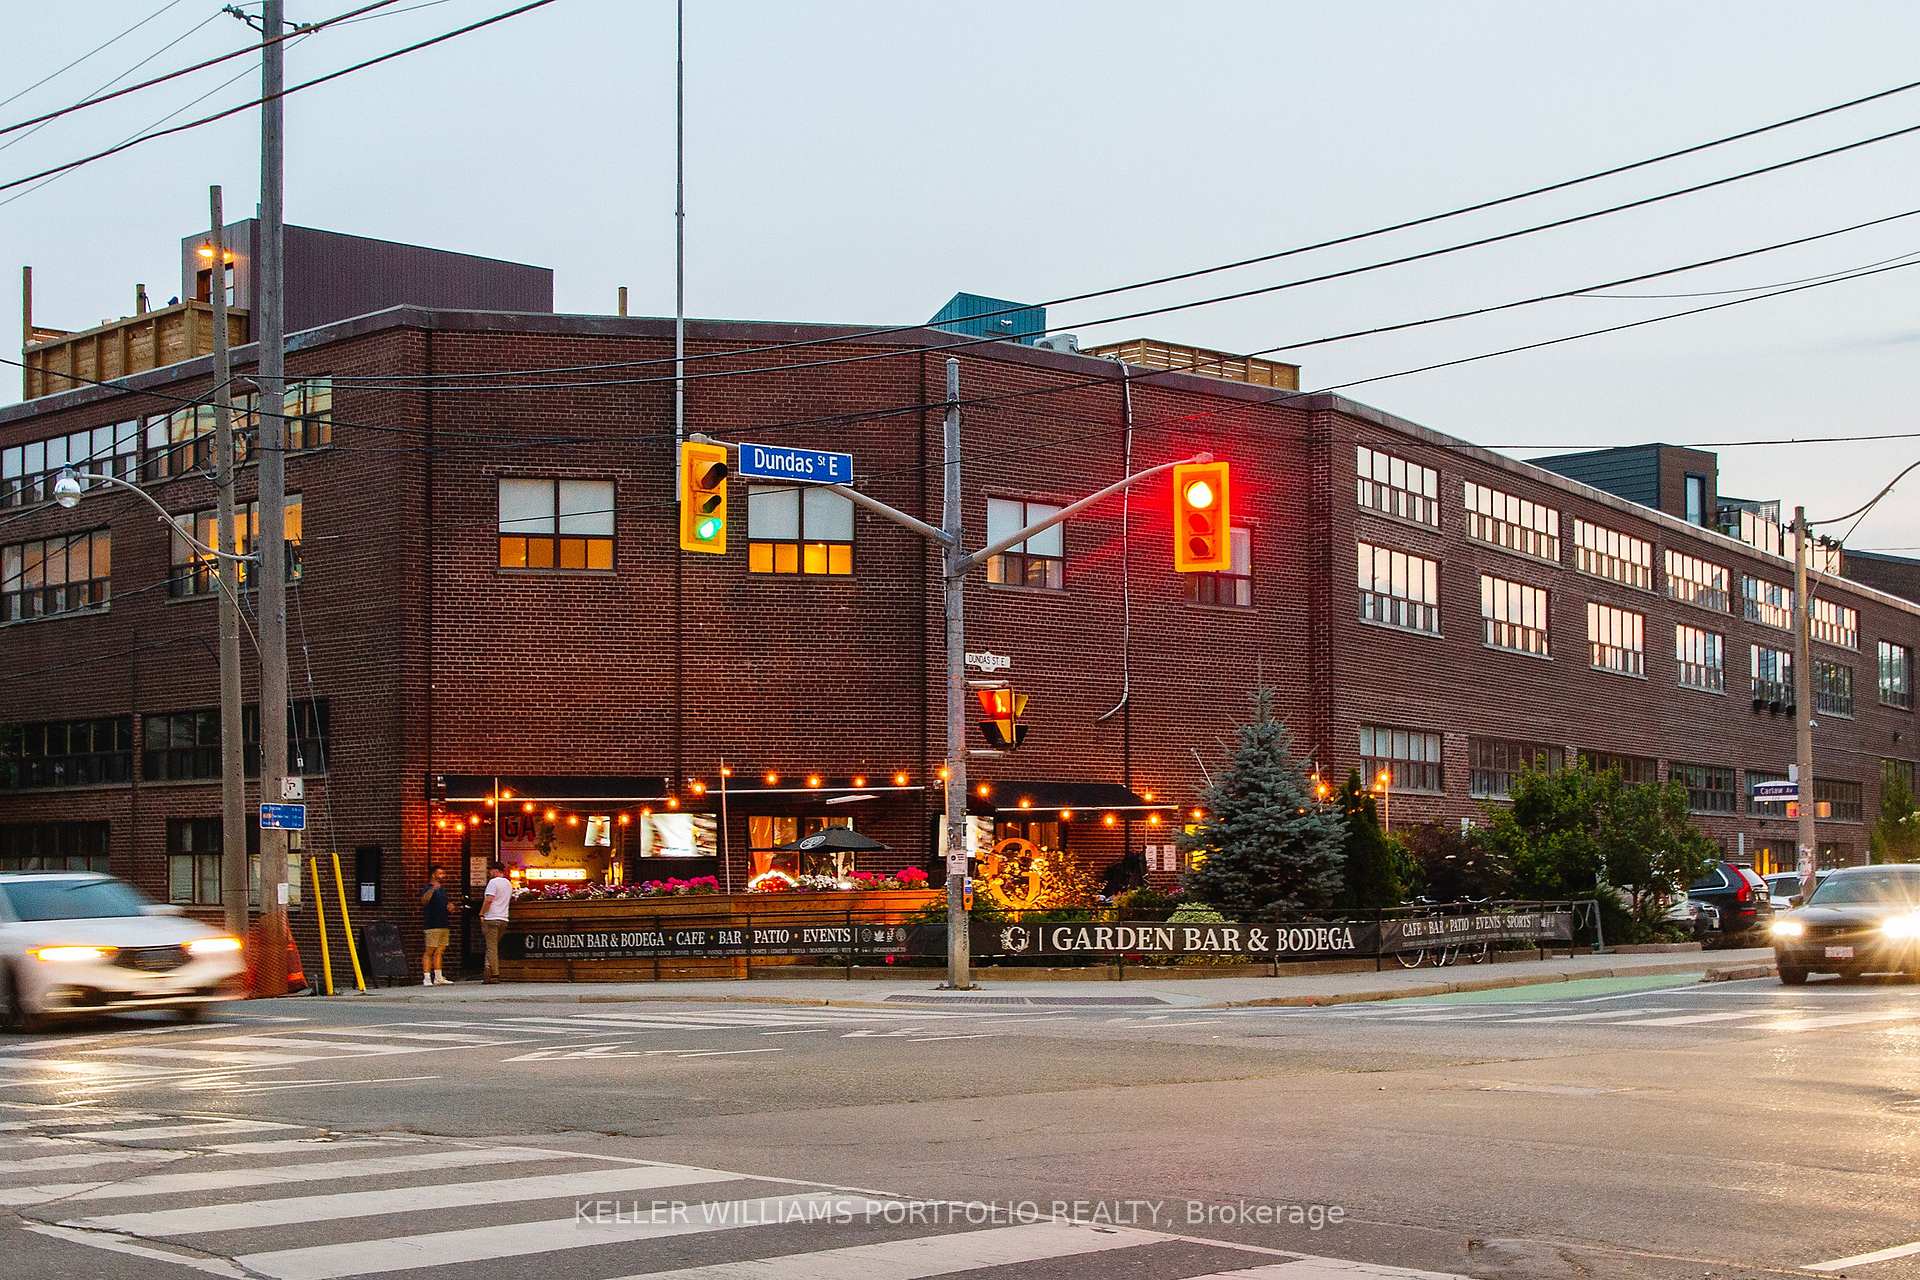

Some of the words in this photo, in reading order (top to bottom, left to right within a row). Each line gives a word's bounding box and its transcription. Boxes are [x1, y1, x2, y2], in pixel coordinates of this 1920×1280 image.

[754, 448, 814, 473] Dundas
[817, 455, 826, 466] St
[829, 456, 838, 476] E
[968, 654, 991, 665] DUNDAS
[1402, 922, 1423, 937] CAFE
[1428, 920, 1445, 934] BAR
[1449, 917, 1470, 932] PATIO
[1475, 916, 1501, 930] EVENTS
[1506, 913, 1531, 929] SPORTS
[542, 934, 585, 949] GARDEN
[587, 933, 609, 948] BAR
[610, 933, 619, 948] &
[621, 932, 666, 947] BODEGA
[676, 931, 706, 945] CAFE
[718, 930, 742, 945] BAR
[753, 929, 790, 944] PATIO
[803, 928, 851, 943] EVENTS
[1052, 927, 1176, 951] GARDEN
[1183, 928, 1241, 951] BAR
[1247, 928, 1269, 951] &
[1276, 927, 1356, 951] BODEGA
